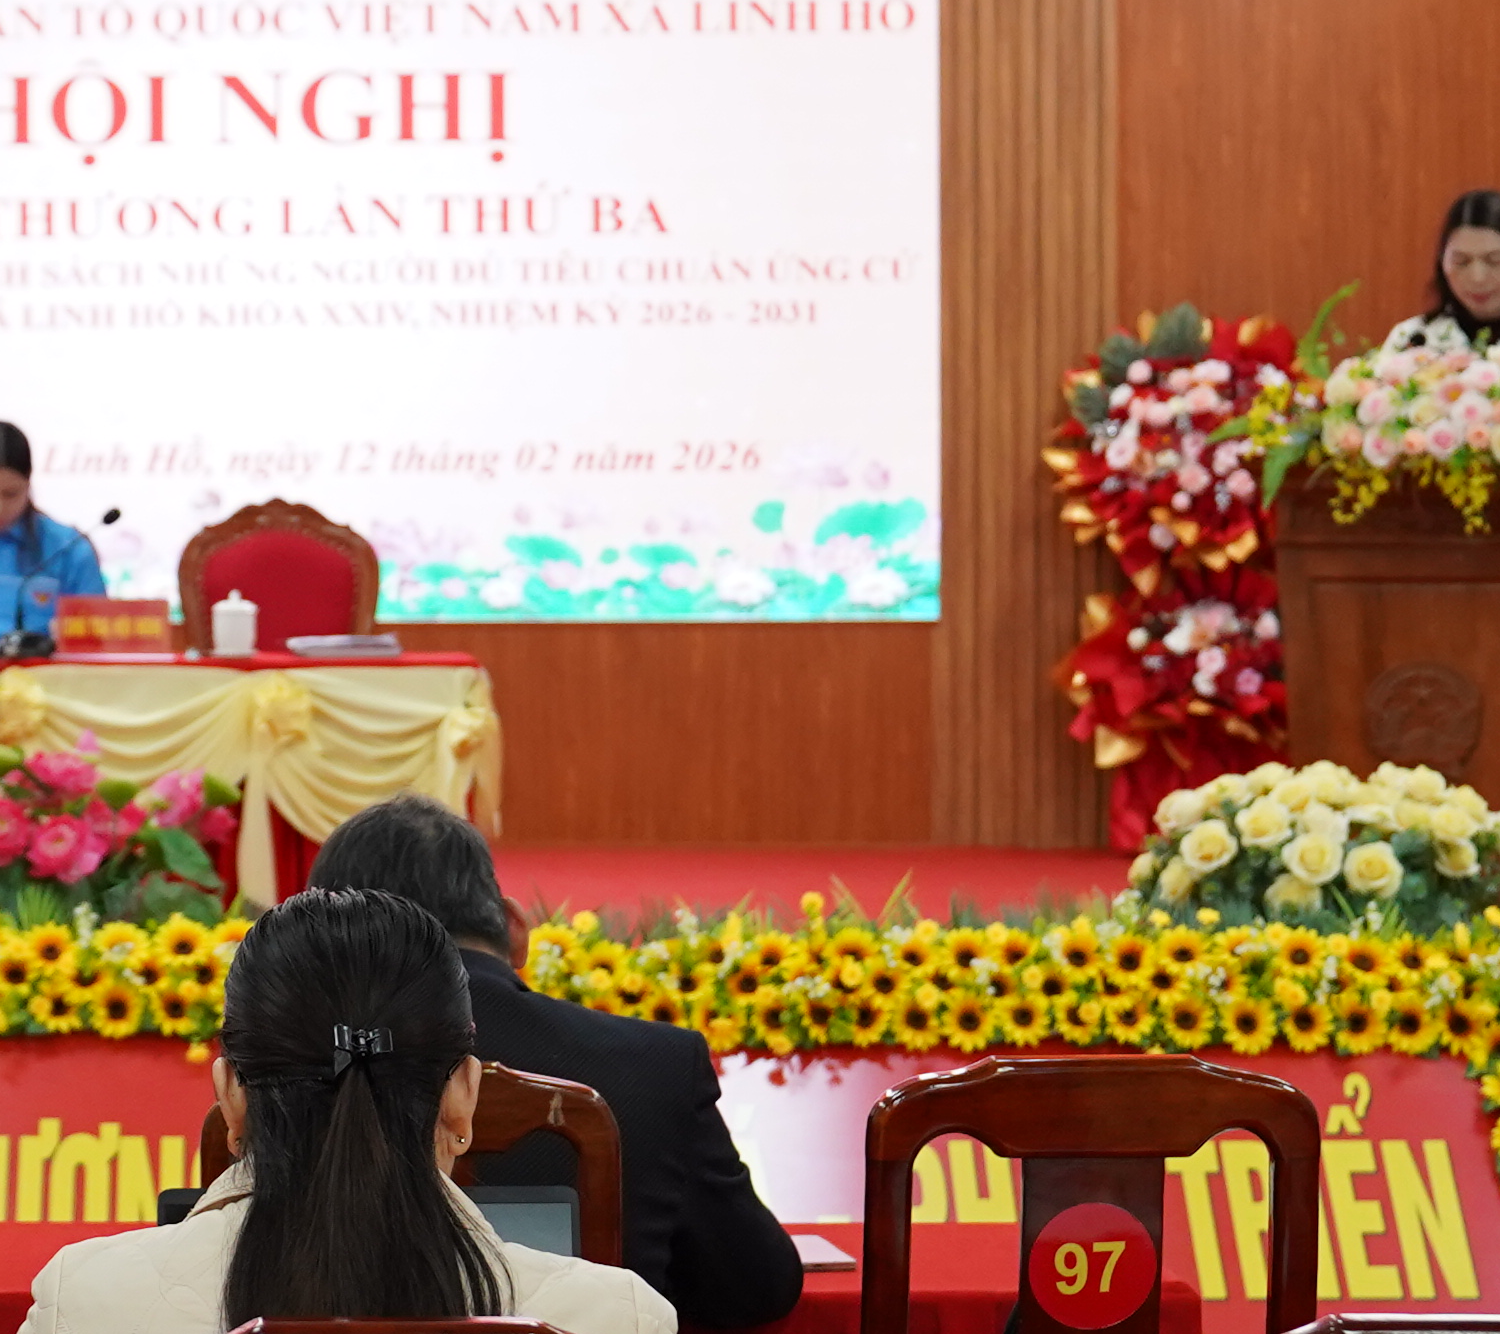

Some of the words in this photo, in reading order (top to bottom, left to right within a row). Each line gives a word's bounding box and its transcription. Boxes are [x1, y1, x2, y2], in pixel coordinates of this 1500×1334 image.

[462, 0, 583, 34] NAM
[689, 0, 819, 34] LINH
[213, 69, 516, 163] NGHỊ
[275, 183, 409, 239] LẦN
[426, 180, 572, 239] THỨ
[590, 196, 670, 237] BA
[334, 442, 380, 474] 12
[513, 441, 561, 473] 02
[669, 441, 763, 473] 2026
[1053, 1239, 1127, 1295] 97
